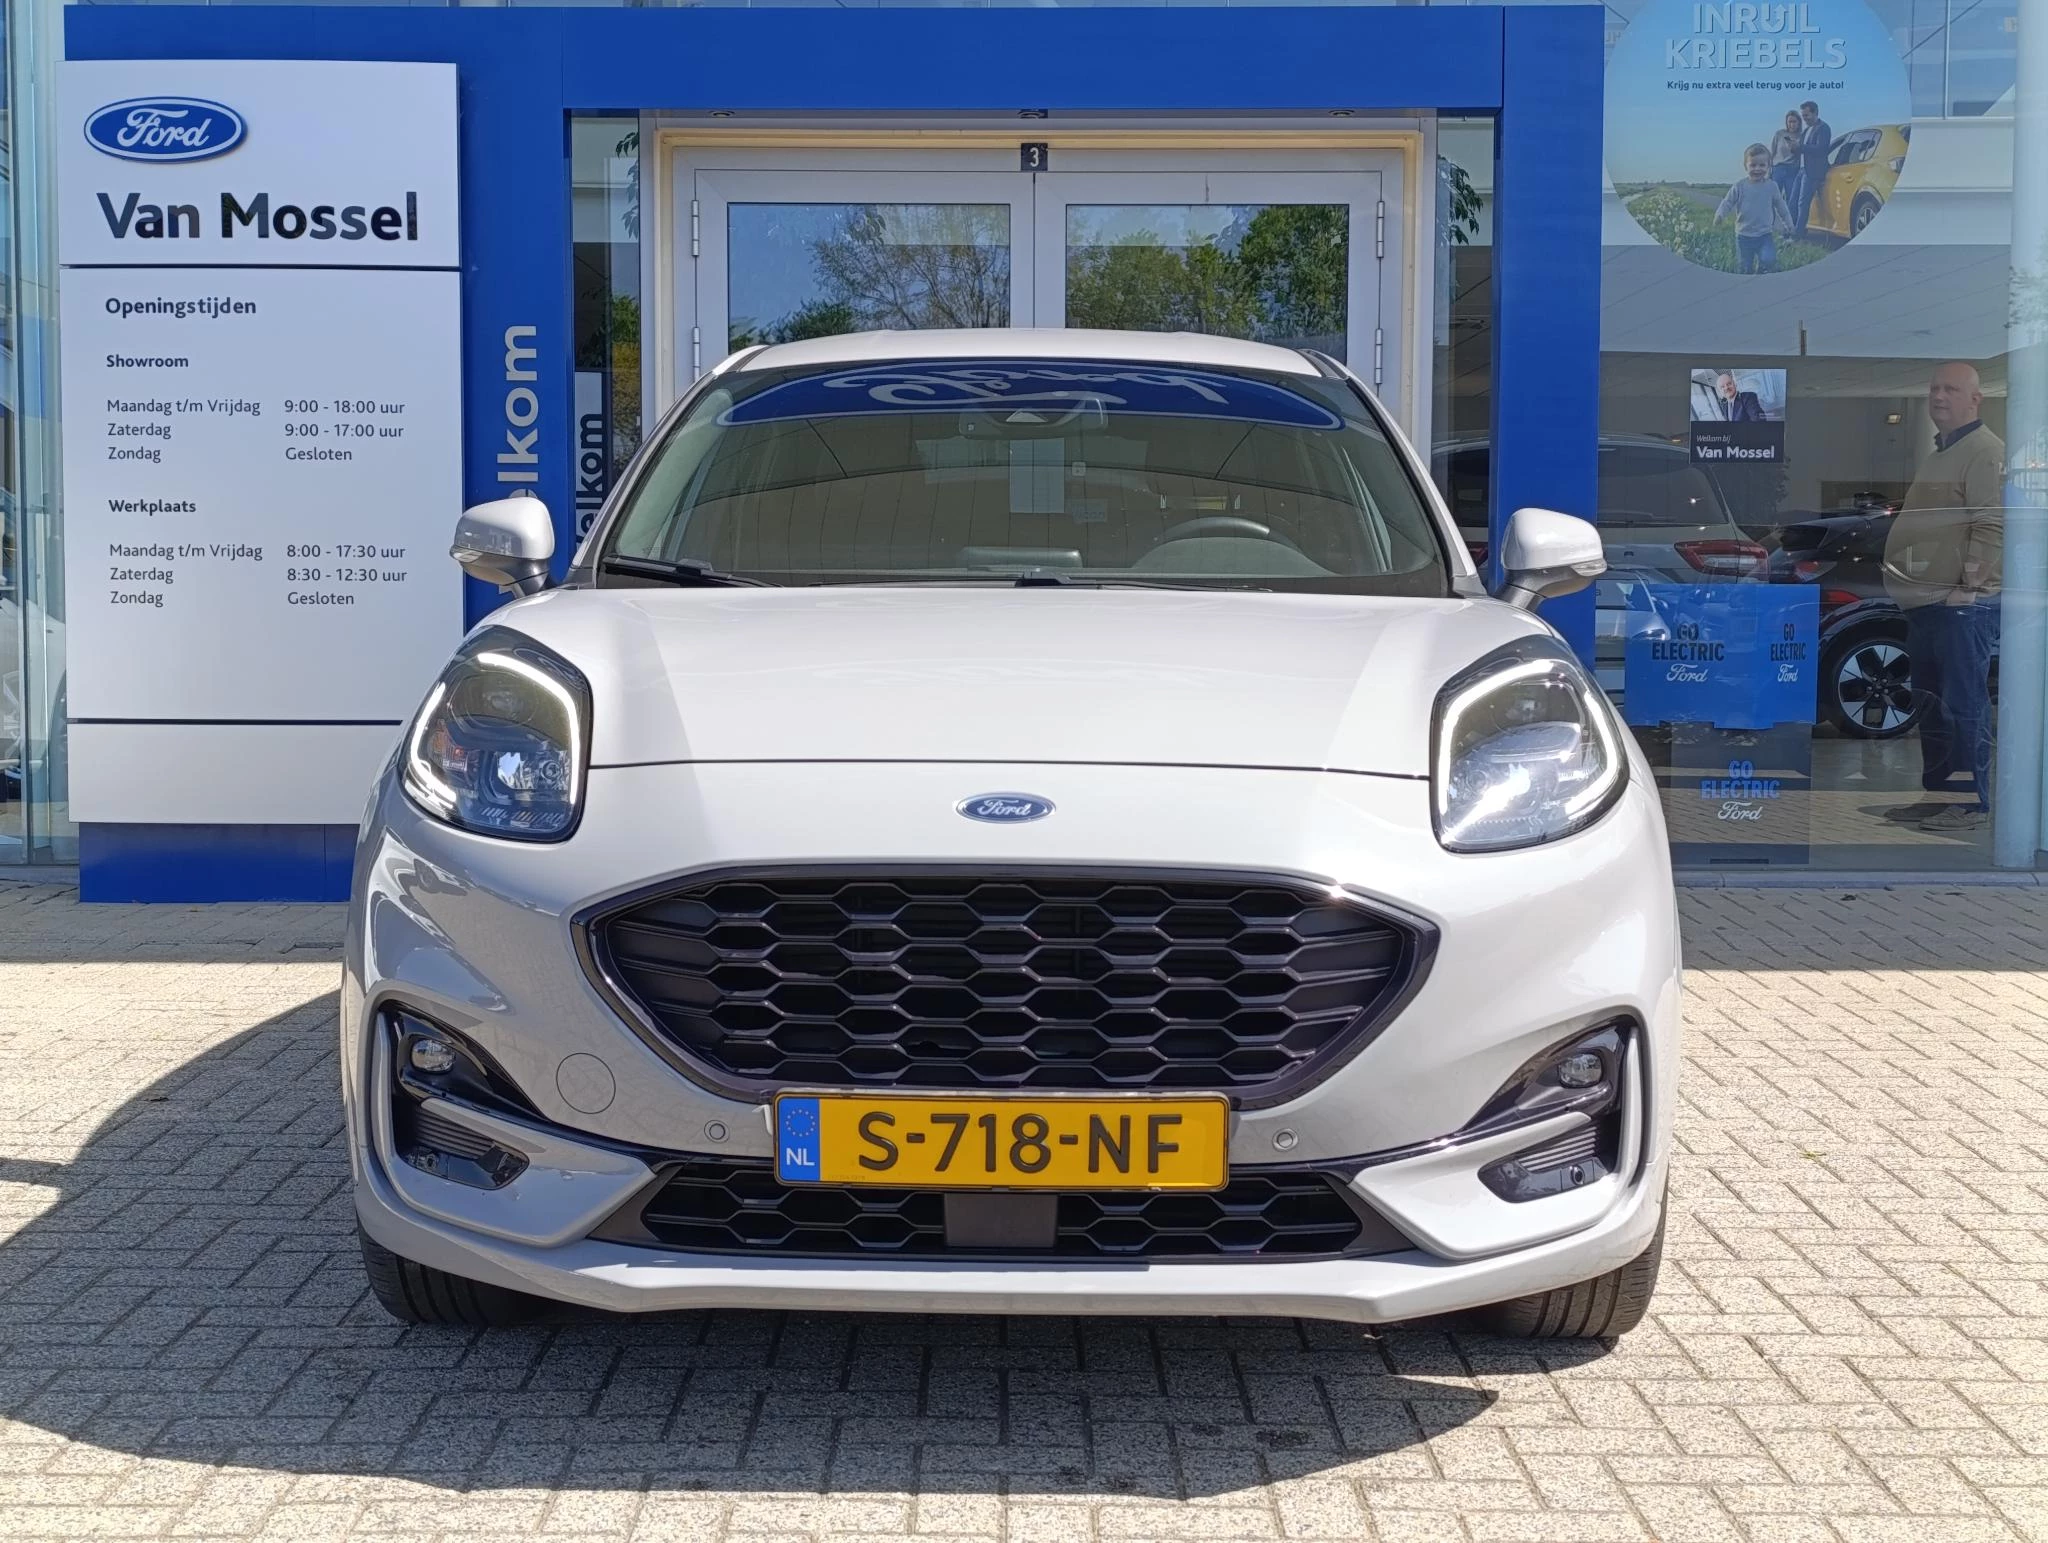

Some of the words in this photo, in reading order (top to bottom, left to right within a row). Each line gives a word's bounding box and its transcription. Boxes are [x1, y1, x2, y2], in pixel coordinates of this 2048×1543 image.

[1665, 38, 1848, 70] KRIEBELS
[1667, 81, 1689, 91] Krijg
[1734, 81, 1753, 89] veel
[1756, 82, 1782, 91] terug
[1808, 81, 1817, 91] je
[1819, 81, 1844, 89] auto!
[117, 108, 212, 147] Ford
[1030, 147, 1040, 167] 3
[96, 193, 200, 238] Van
[220, 191, 418, 241] Mossel
[106, 297, 256, 318] Openingstijden
[107, 354, 188, 367] Showroom
[108, 399, 172, 416] Maandag
[176, 399, 202, 412] t/m
[207, 399, 260, 416] Vrijdag
[285, 400, 318, 412] 9:00
[334, 401, 375, 413] 18:00
[381, 404, 405, 413] uur
[108, 423, 171, 439] Zaterdag
[285, 424, 318, 436] 9:00
[334, 424, 374, 437] 17:00
[380, 428, 403, 437] uur
[108, 446, 161, 463] Zondag
[286, 447, 352, 460] Gesloten
[1696, 446, 1722, 458] Van
[1727, 446, 1775, 458] Mossel
[109, 499, 196, 516] Werkplaats
[110, 544, 174, 560] Maandag
[178, 544, 205, 557] t/m
[210, 544, 262, 561] Vrijdag
[287, 545, 320, 557] 8:00
[336, 545, 376, 557] 17:30
[381, 549, 405, 558] uur
[110, 567, 173, 584] Zaterdag
[288, 568, 320, 581] 8:30
[336, 569, 377, 581] 12:30
[383, 572, 407, 581] uur
[111, 591, 163, 607] Zondag
[288, 592, 354, 604] Gesloten
[1678, 623, 1698, 640] GO
[1784, 624, 1794, 640] GO
[1652, 642, 1725, 661] ELECTRIC
[1771, 643, 1806, 661] ELECTRIC
[1666, 663, 1708, 682] Ford
[1777, 664, 1798, 682] Ford
[1729, 760, 1753, 778] GO
[1701, 780, 1780, 799] ELECTRIC
[977, 799, 1032, 815] Ford
[1718, 801, 1763, 820] Ford
[858, 1111, 1183, 1174] S-718-NF
[786, 1147, 815, 1166] NL
